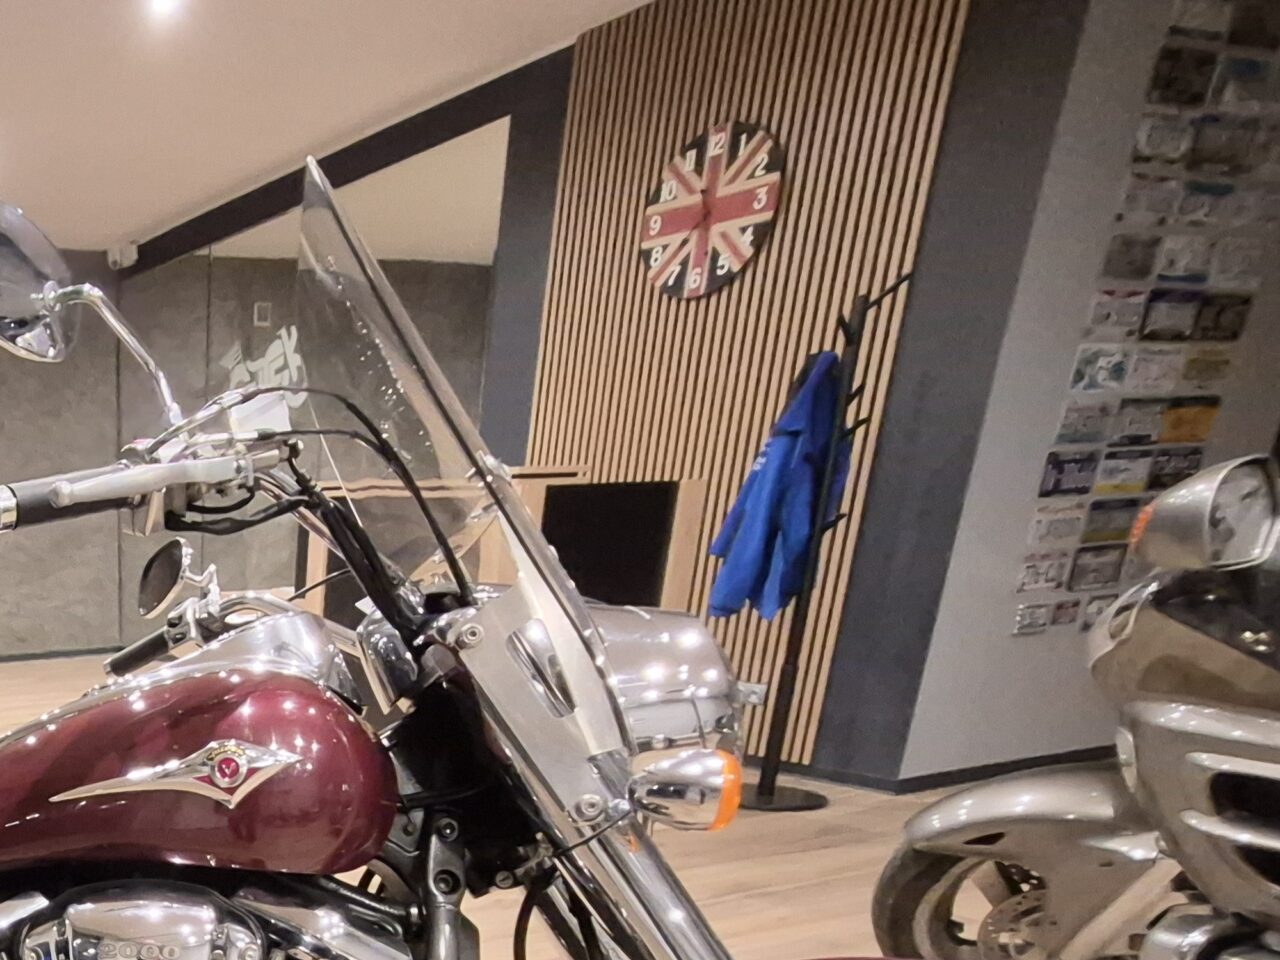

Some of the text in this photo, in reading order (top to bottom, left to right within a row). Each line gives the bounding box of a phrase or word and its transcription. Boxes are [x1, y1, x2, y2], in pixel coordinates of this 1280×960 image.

[708, 132, 726, 157] 12
[738, 133, 747, 156] 1
[754, 154, 768, 177] 2
[660, 180, 677, 203] 10
[753, 186, 769, 209] 3
[649, 215, 662, 236] 9
[650, 246, 663, 268] 8
[716, 252, 730, 275] 5
[668, 265, 682, 286] 7
[689, 267, 702, 289] 6
[98, 941, 181, 960] 2000
